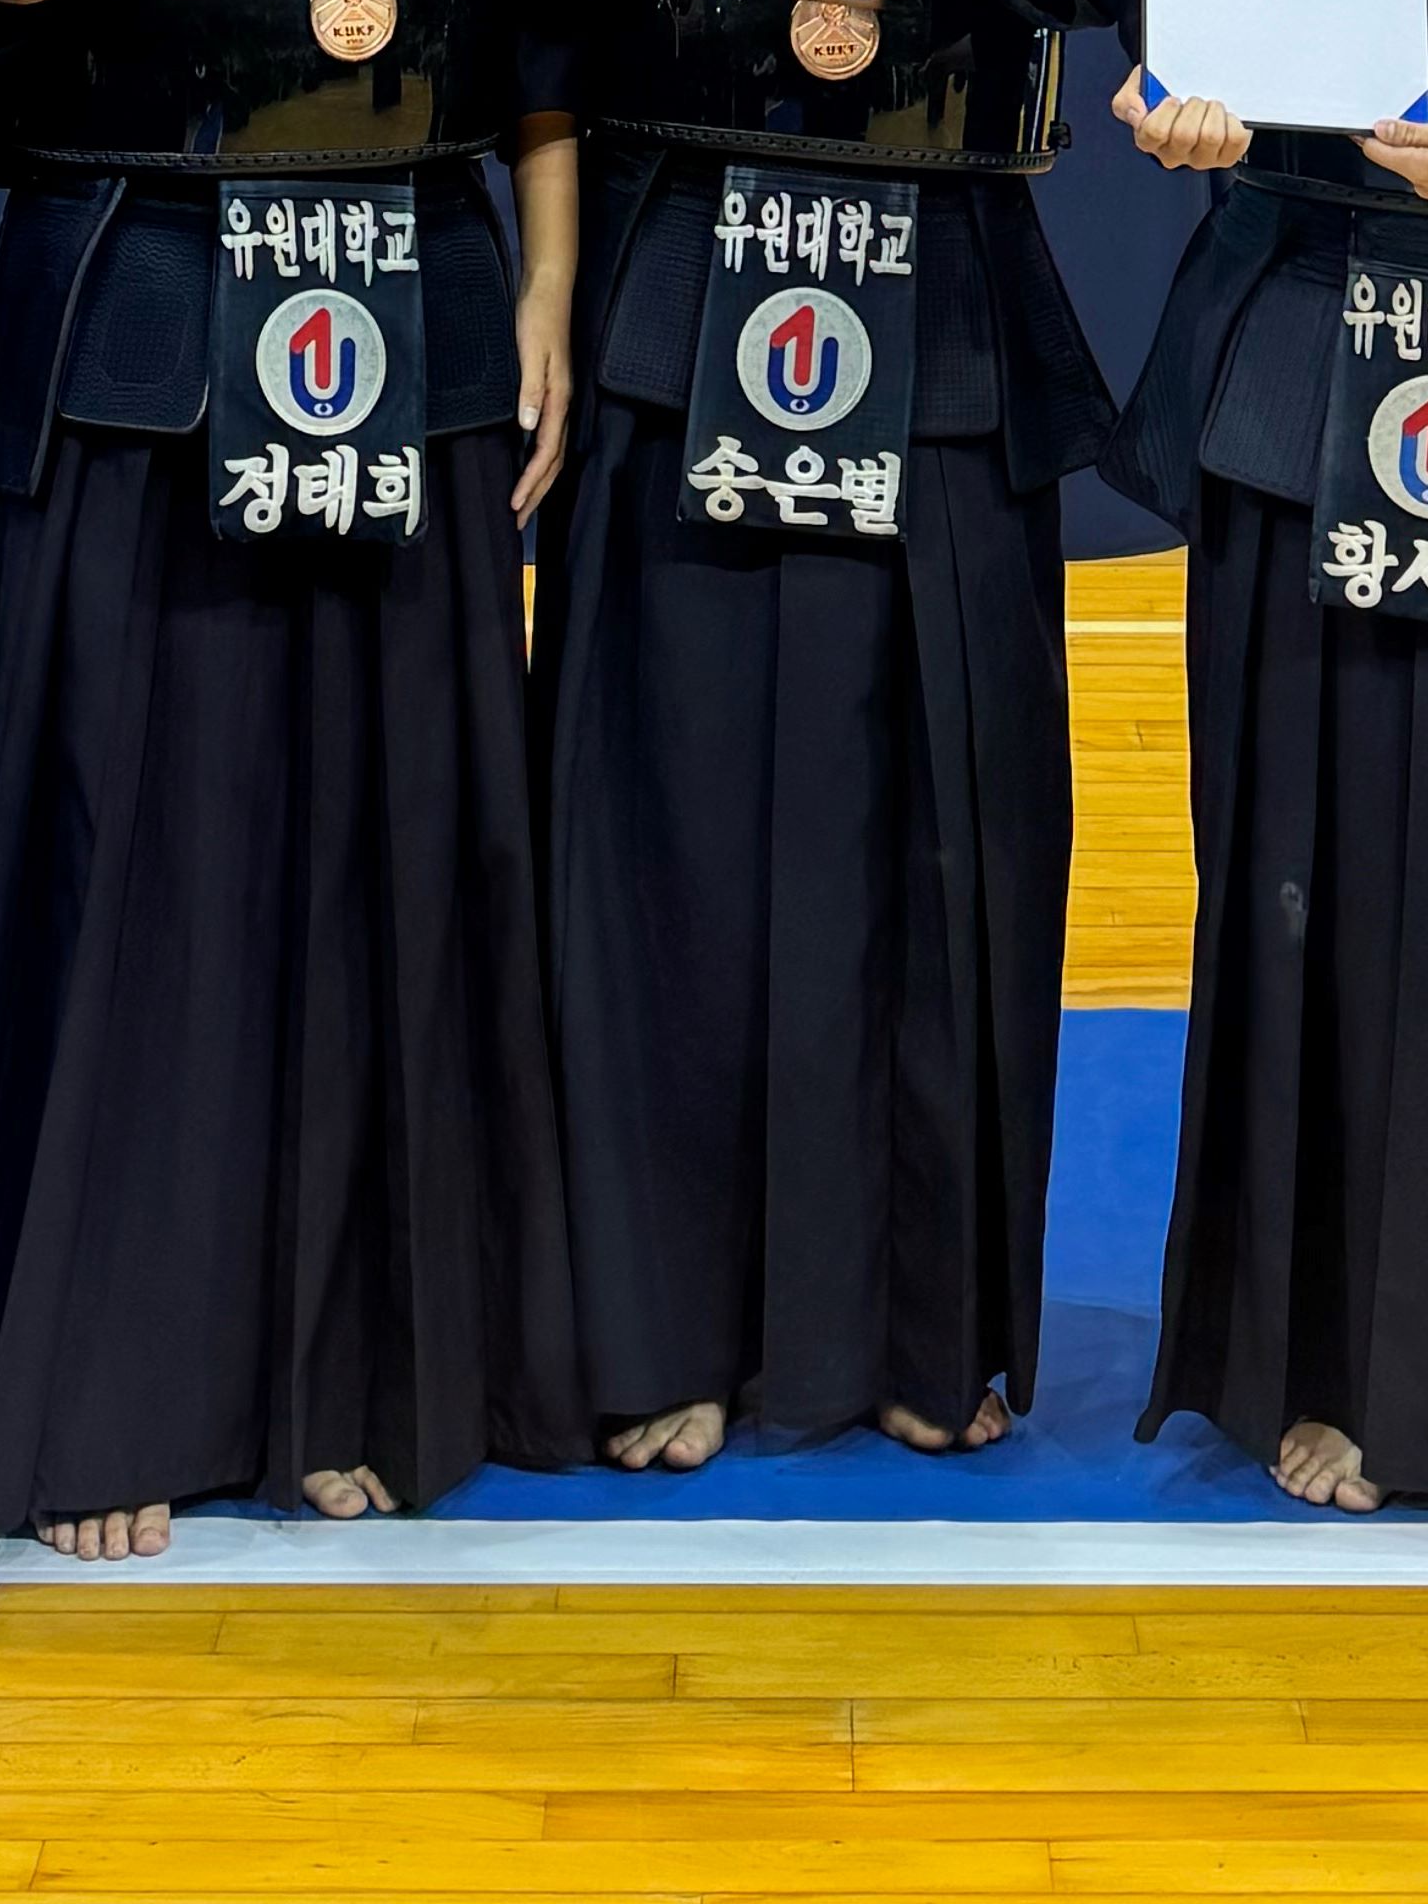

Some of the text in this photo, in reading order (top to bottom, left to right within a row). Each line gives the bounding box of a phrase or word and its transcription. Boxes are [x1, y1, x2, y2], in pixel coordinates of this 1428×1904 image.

[220, 198, 420, 287] 유원대학교
[714, 190, 913, 286] 유원대학교
[218, 444, 422, 537] 정태희
[687, 435, 901, 536] 송은별
